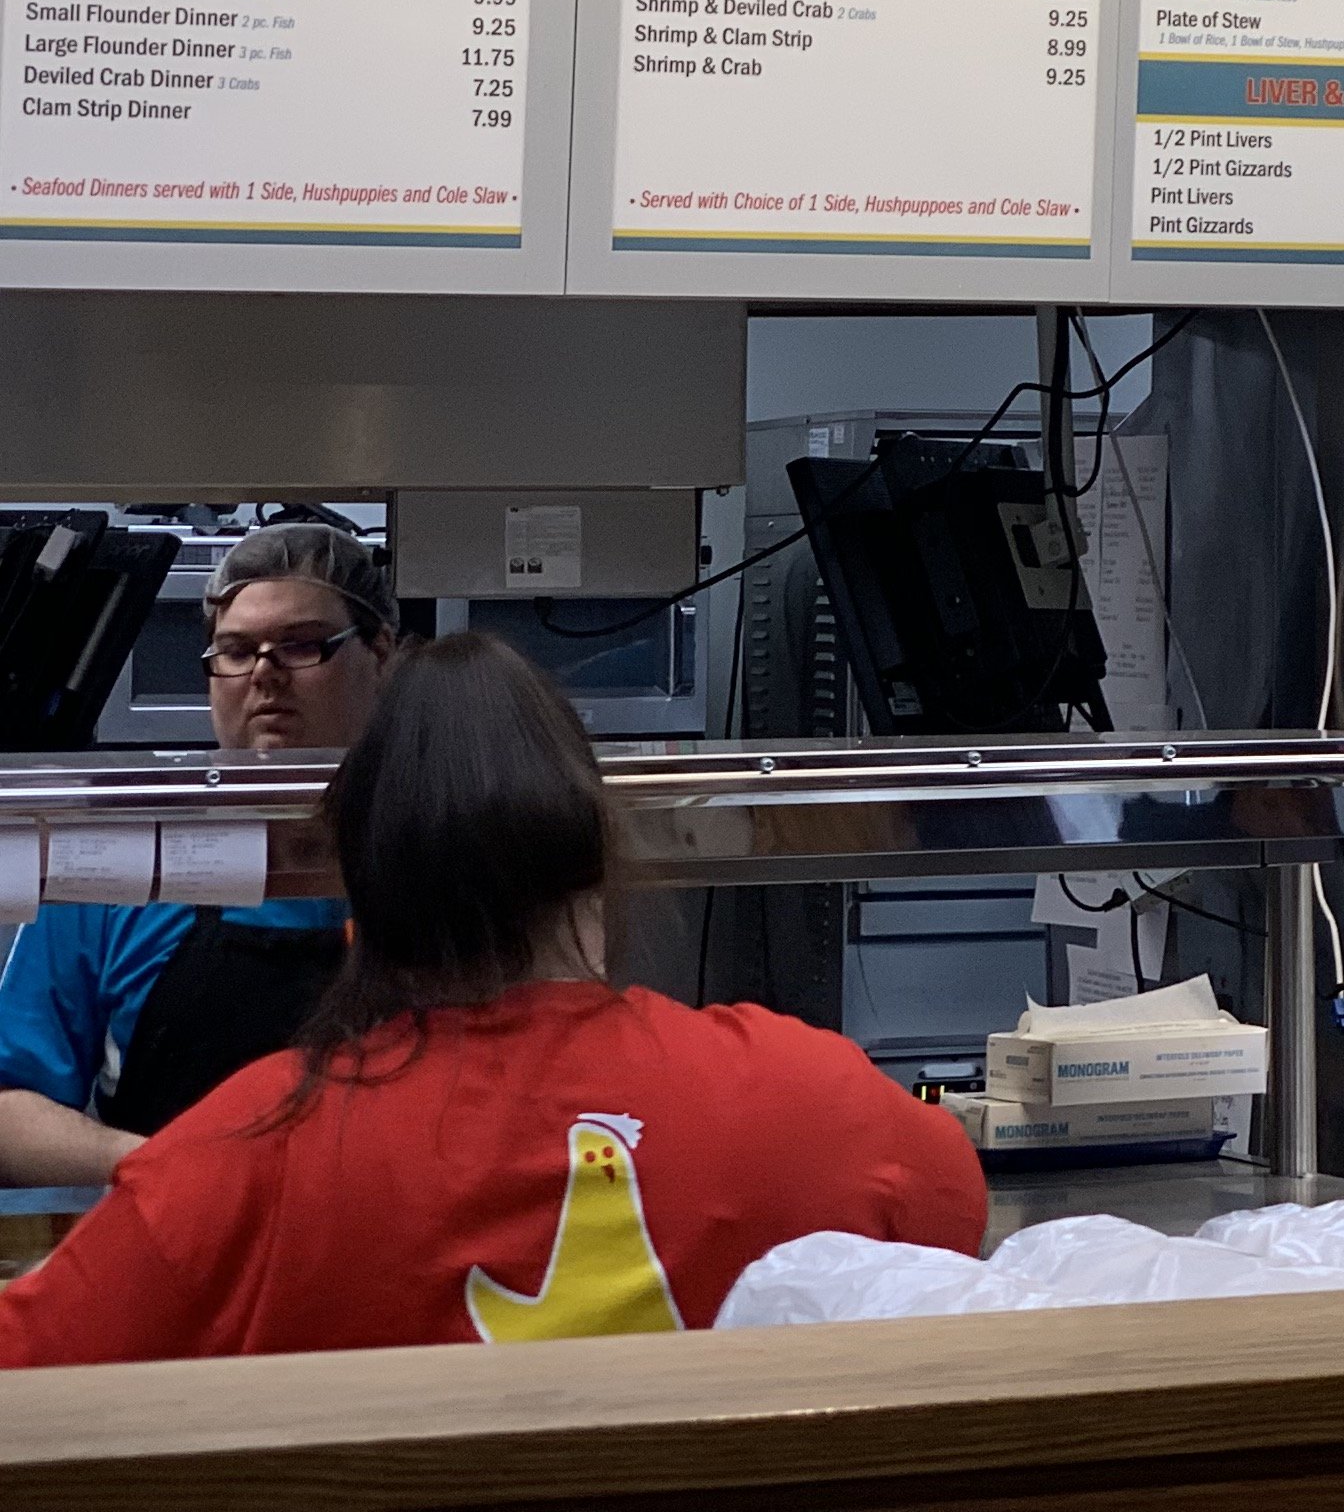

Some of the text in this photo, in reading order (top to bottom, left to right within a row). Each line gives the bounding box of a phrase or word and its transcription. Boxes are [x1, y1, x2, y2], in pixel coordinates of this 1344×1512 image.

[792, 0, 833, 18] Crab
[1048, 9, 1087, 27] 9.25
[1246, 78, 1317, 104] LIVER
[1323, 80, 1344, 106] &
[22, 96, 511, 127] Clam Strip Dinner 7.99
[1153, 157, 1184, 178] 1/2
[1189, 158, 1221, 176] Pint
[1225, 159, 1292, 178] Gizzards
[21, 176, 508, 206] Seafood Dinners served with 1 Side, Hushpuppies and Cole Slaw
[639, 189, 1071, 217] Served with Choice of 1 Side, Hushpuppoes and Cole Slaw
[1057, 1061, 1130, 1079] MONOGRAM
[994, 1121, 1069, 1140] MONOGRAM
